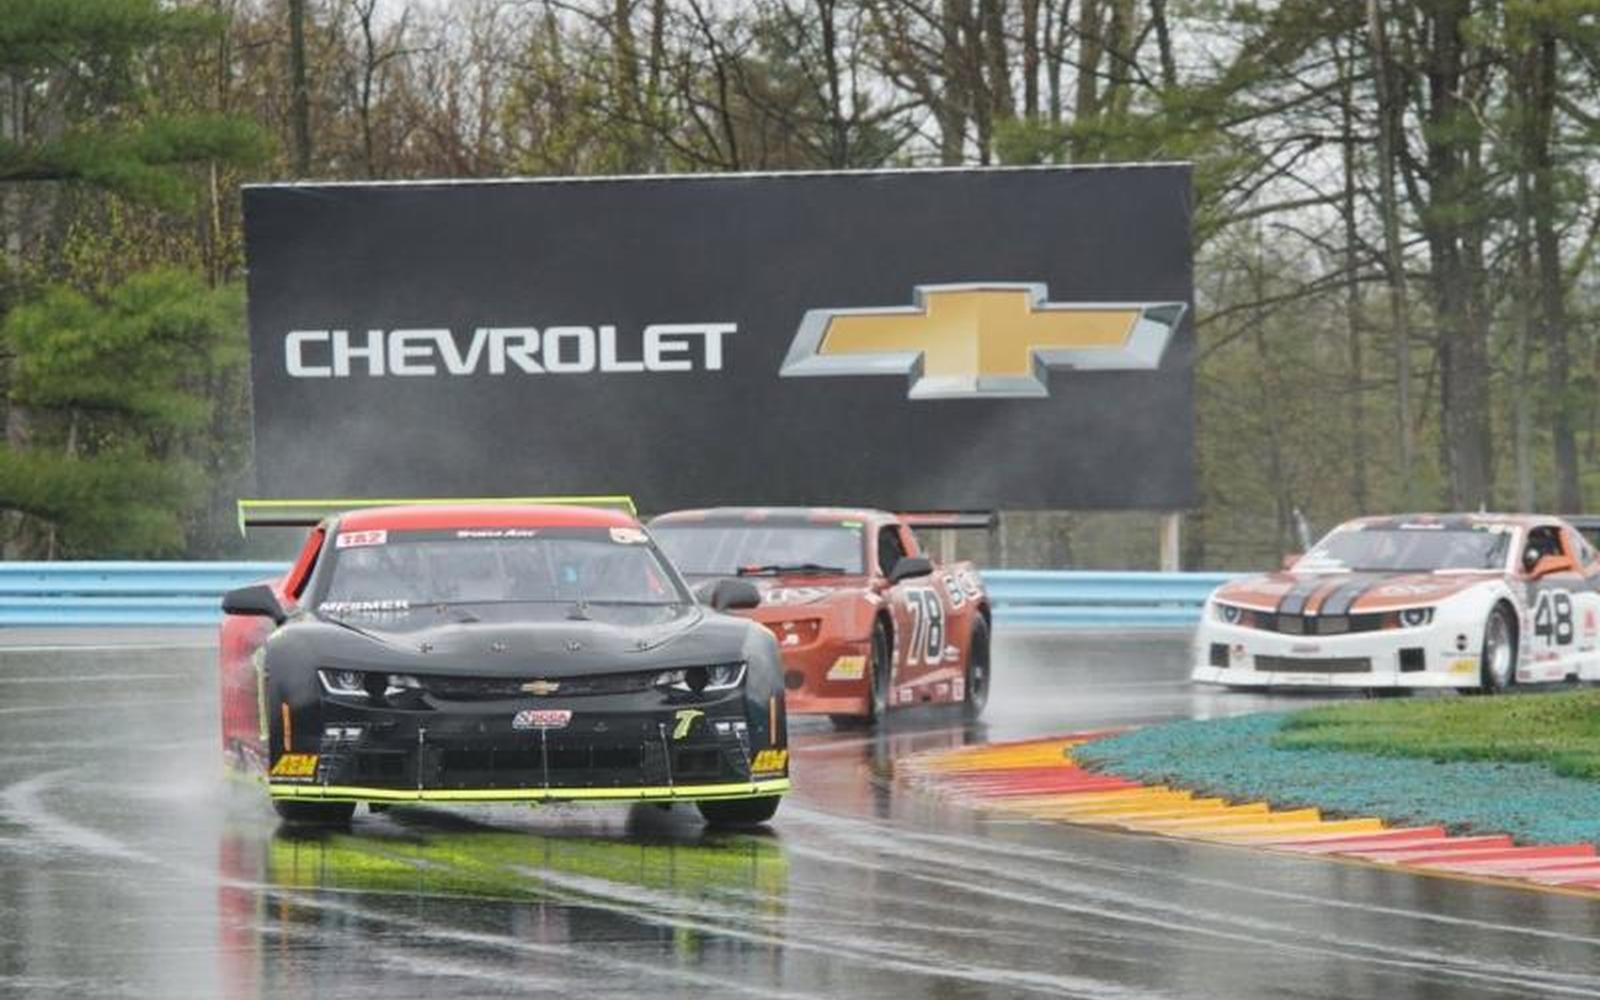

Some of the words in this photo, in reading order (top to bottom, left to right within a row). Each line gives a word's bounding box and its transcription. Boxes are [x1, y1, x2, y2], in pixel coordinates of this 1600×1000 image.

[285, 322, 738, 377] CHEVROLET
[904, 586, 945, 666] 78
[1534, 591, 1574, 648] 48
